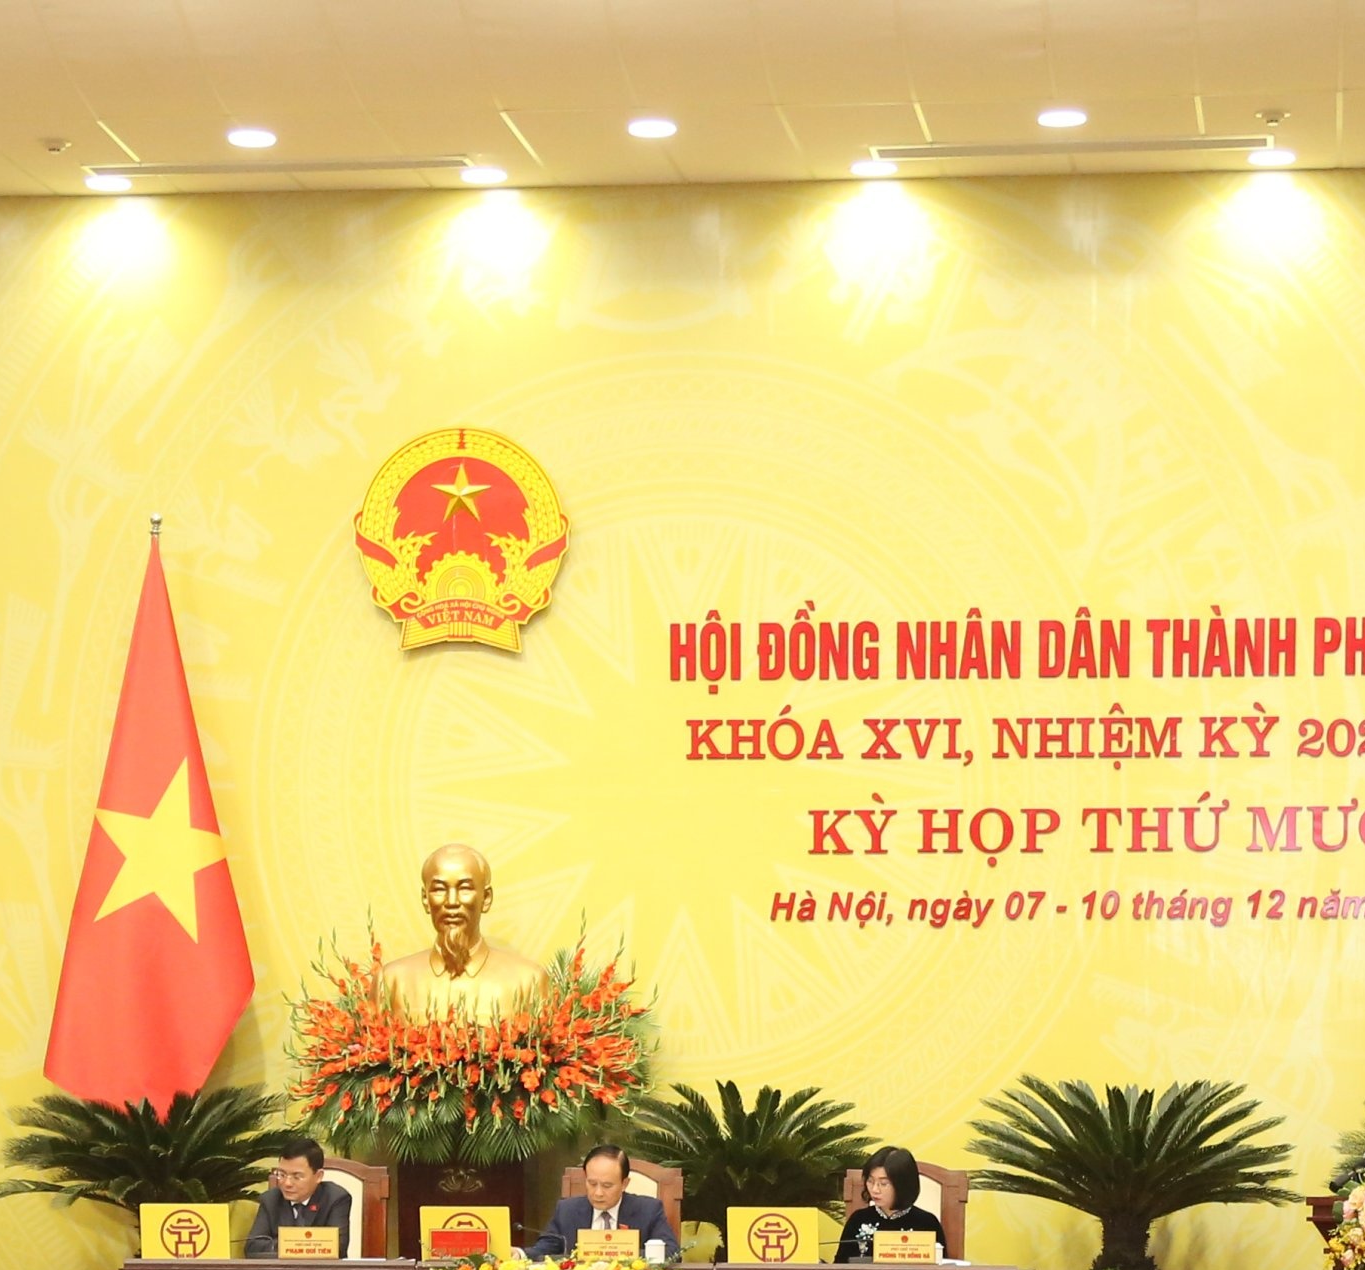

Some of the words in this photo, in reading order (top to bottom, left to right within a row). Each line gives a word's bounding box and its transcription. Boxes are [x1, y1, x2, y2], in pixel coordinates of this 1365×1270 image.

[426, 609, 460, 625] VIỆT
[464, 610, 495, 626] NAM
[670, 610, 741, 694] HỘI
[757, 600, 879, 681] ĐỒNG
[897, 608, 1021, 680] NHÂN
[1039, 607, 1131, 679] DÂN
[1147, 605, 1296, 678] THÀNH
[686, 705, 844, 760] KHÓA
[862, 717, 974, 765] XVI,
[992, 703, 1182, 769] NHIỆM
[1199, 703, 1280, 758] KỲ
[810, 793, 897, 855] KỲ
[919, 807, 1061, 867] HỌP
[1082, 791, 1229, 853] THỨ
[770, 892, 817, 921] Hà
[828, 891, 893, 928] Nội,
[907, 896, 994, 929] ngày
[1005, 890, 1046, 920] 07
[1082, 890, 1120, 919] 10
[1132, 891, 1232, 926] tháng
[1248, 889, 1285, 919] 12
